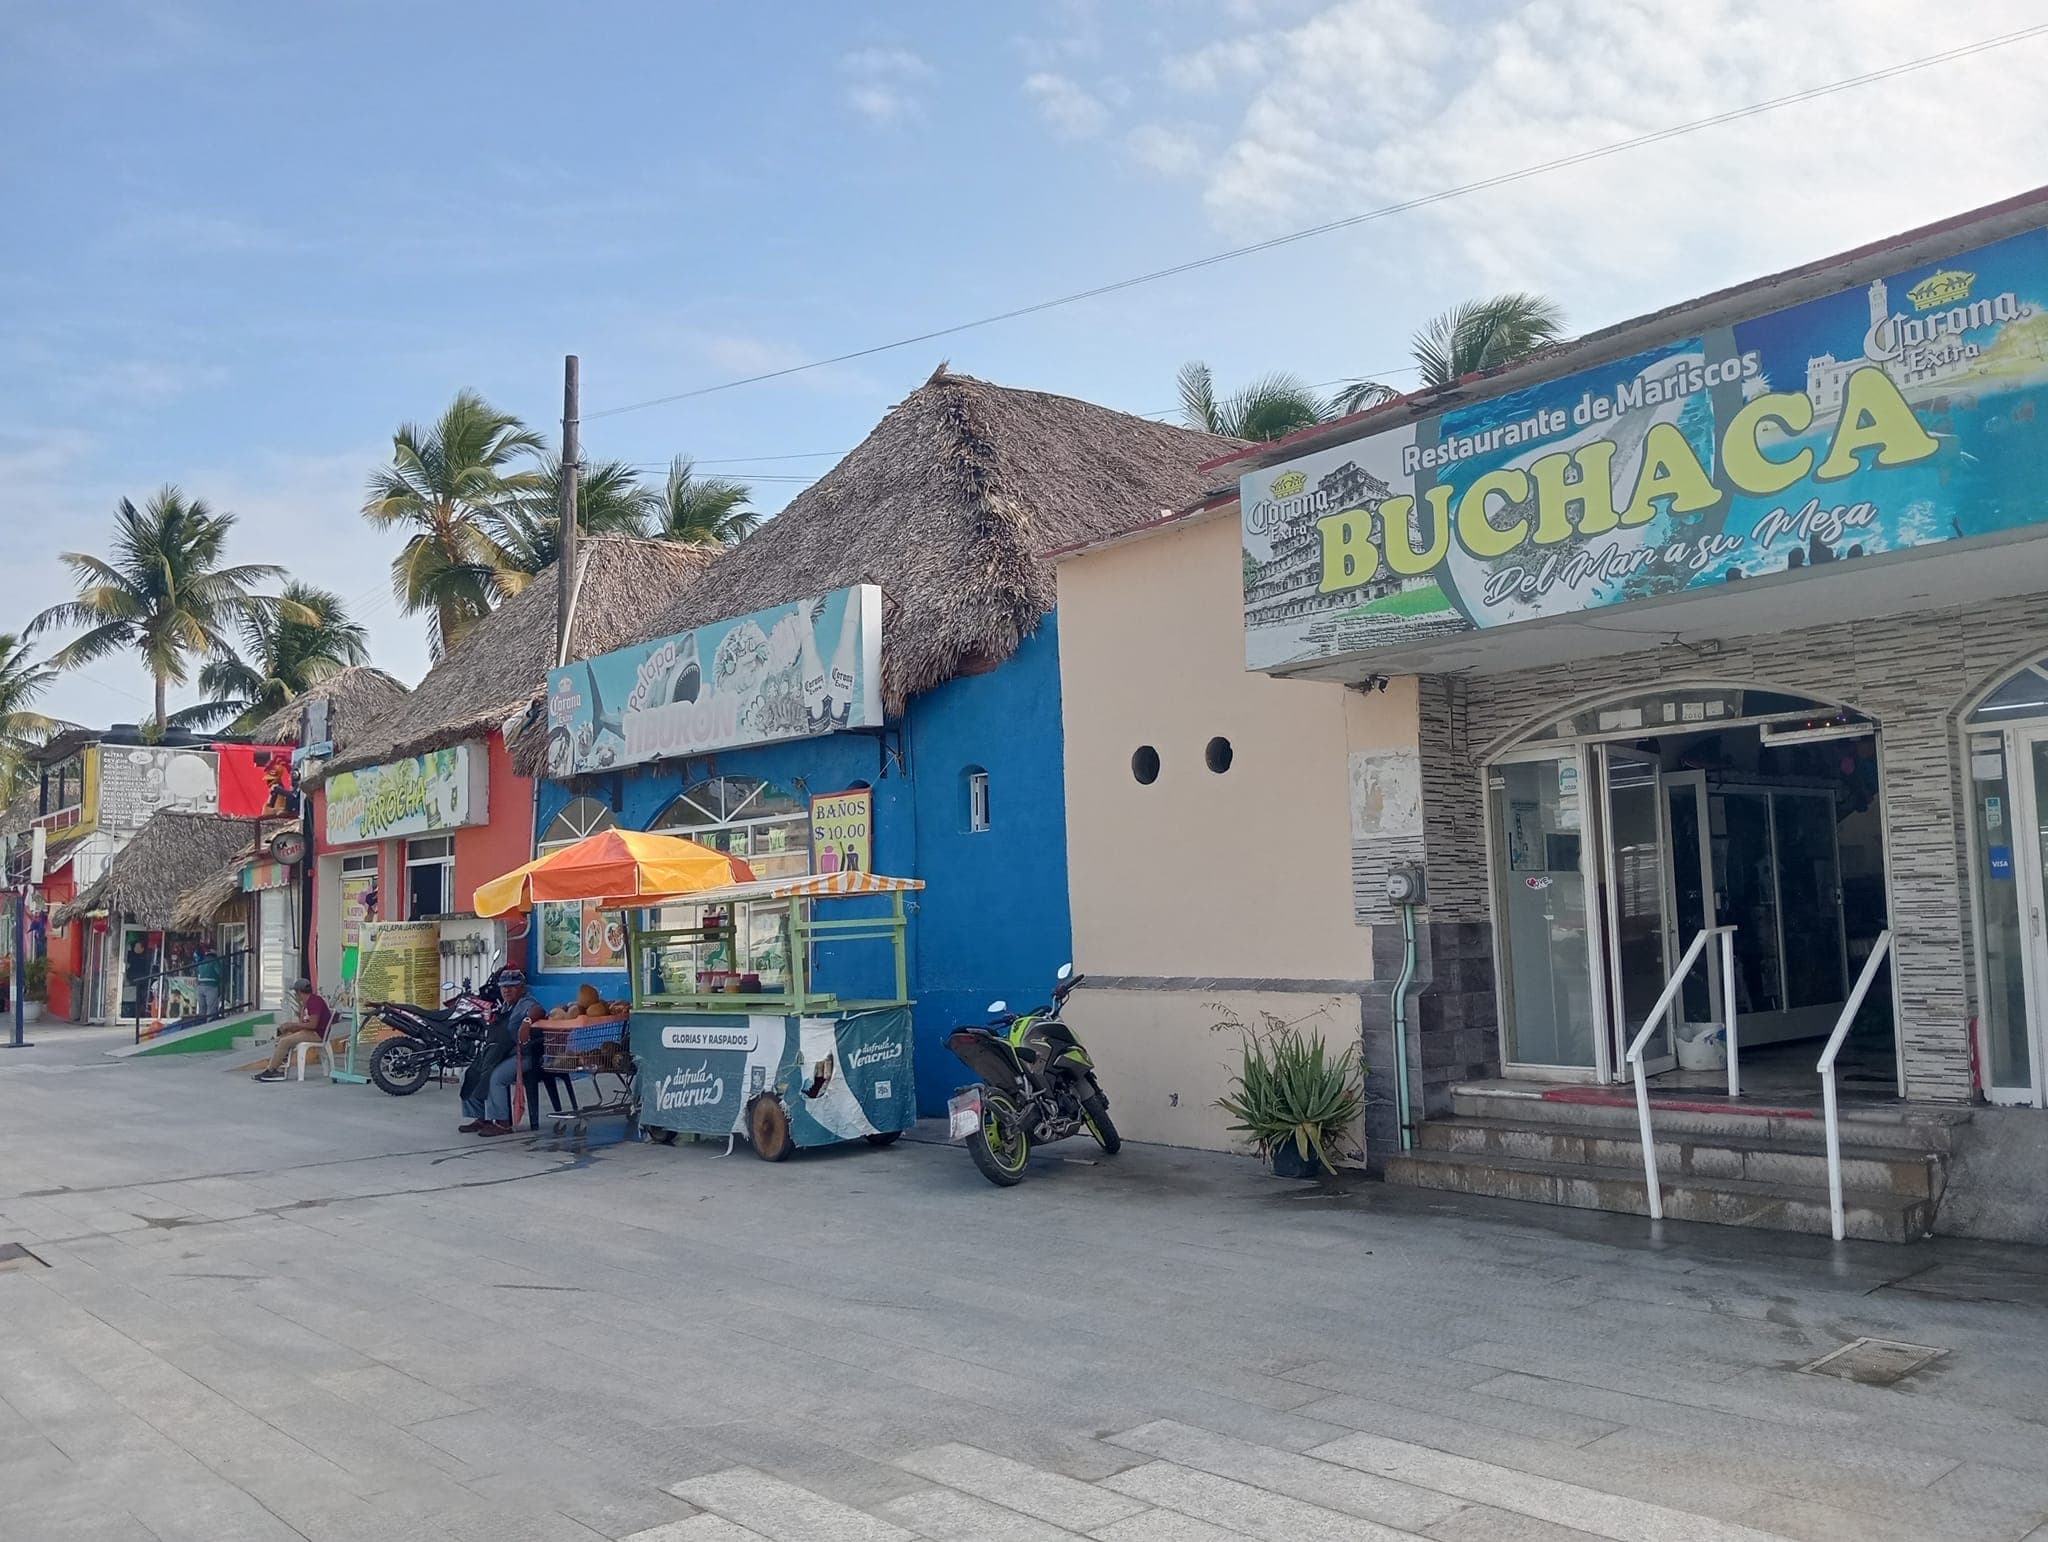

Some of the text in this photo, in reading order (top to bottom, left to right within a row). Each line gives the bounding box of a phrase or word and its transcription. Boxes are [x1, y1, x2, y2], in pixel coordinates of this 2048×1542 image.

[1863, 293, 2023, 362] Corona
[1911, 343, 1980, 372] Extra
[1403, 351, 1760, 476] Restaurante de Mariscos
[1315, 366, 1940, 594] BUCHACA
[1246, 489, 1331, 536] Corona
[1271, 524, 1307, 544] Extra
[1484, 497, 1878, 606] Del Mar a su Mesa
[629, 641, 677, 712] Palapa
[550, 692, 581, 717] Corona
[360, 776, 426, 838] JAROCHA
[816, 800, 865, 820] BAÑOS
[815, 823, 866, 841] $ 10.00
[1991, 860, 2009, 868] VISA
[672, 1033, 701, 1044] GLORIAS
[708, 1034, 748, 1046] RASPADOS
[848, 1043, 902, 1069] Veracruz
[673, 1058, 713, 1088] disfruta
[655, 1073, 724, 1111] Veracruz
